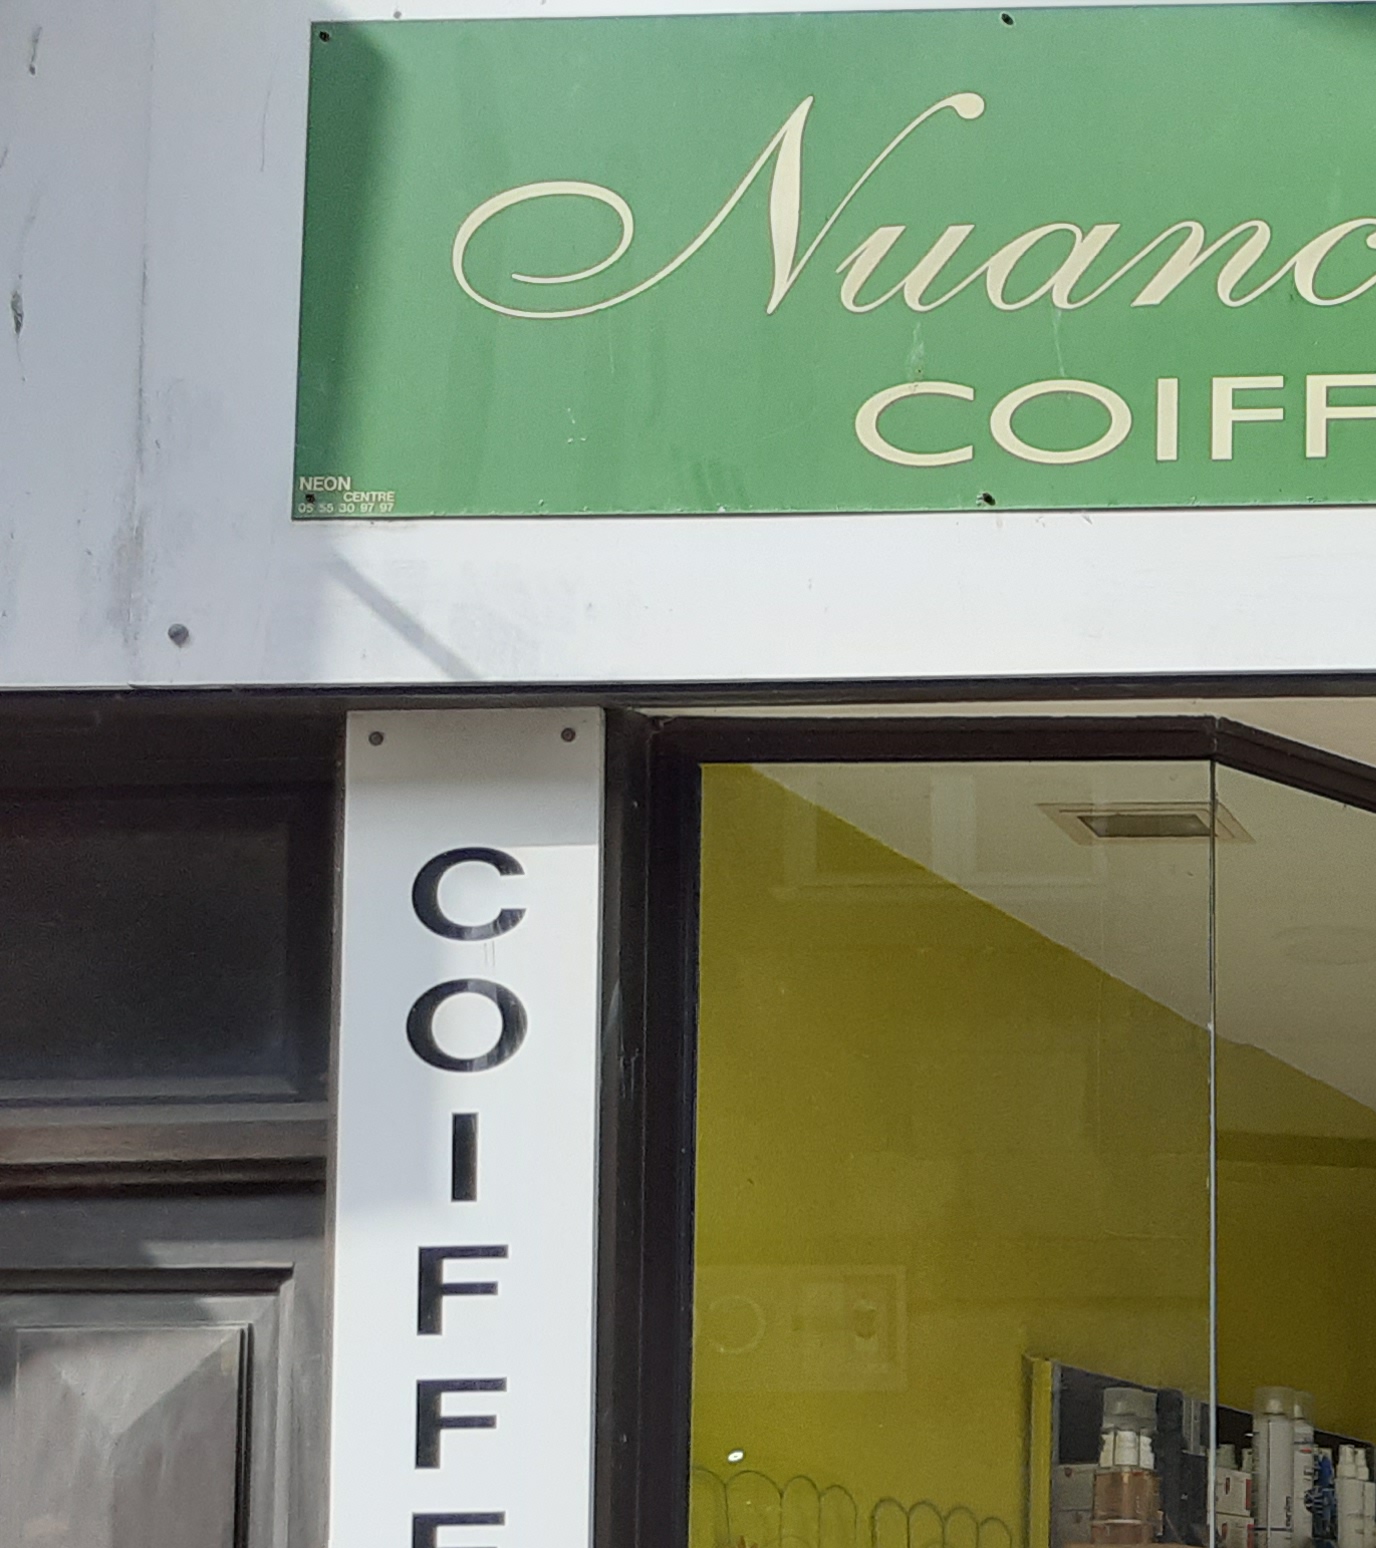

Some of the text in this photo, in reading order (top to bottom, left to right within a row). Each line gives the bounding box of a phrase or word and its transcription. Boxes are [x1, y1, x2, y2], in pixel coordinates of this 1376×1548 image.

[299, 476, 351, 491] NEON
[343, 491, 396, 502] CENTRE
[298, 503, 314, 513] 05
[339, 503, 355, 513] 30
[360, 503, 374, 513] 97
[380, 503, 394, 513] 97
